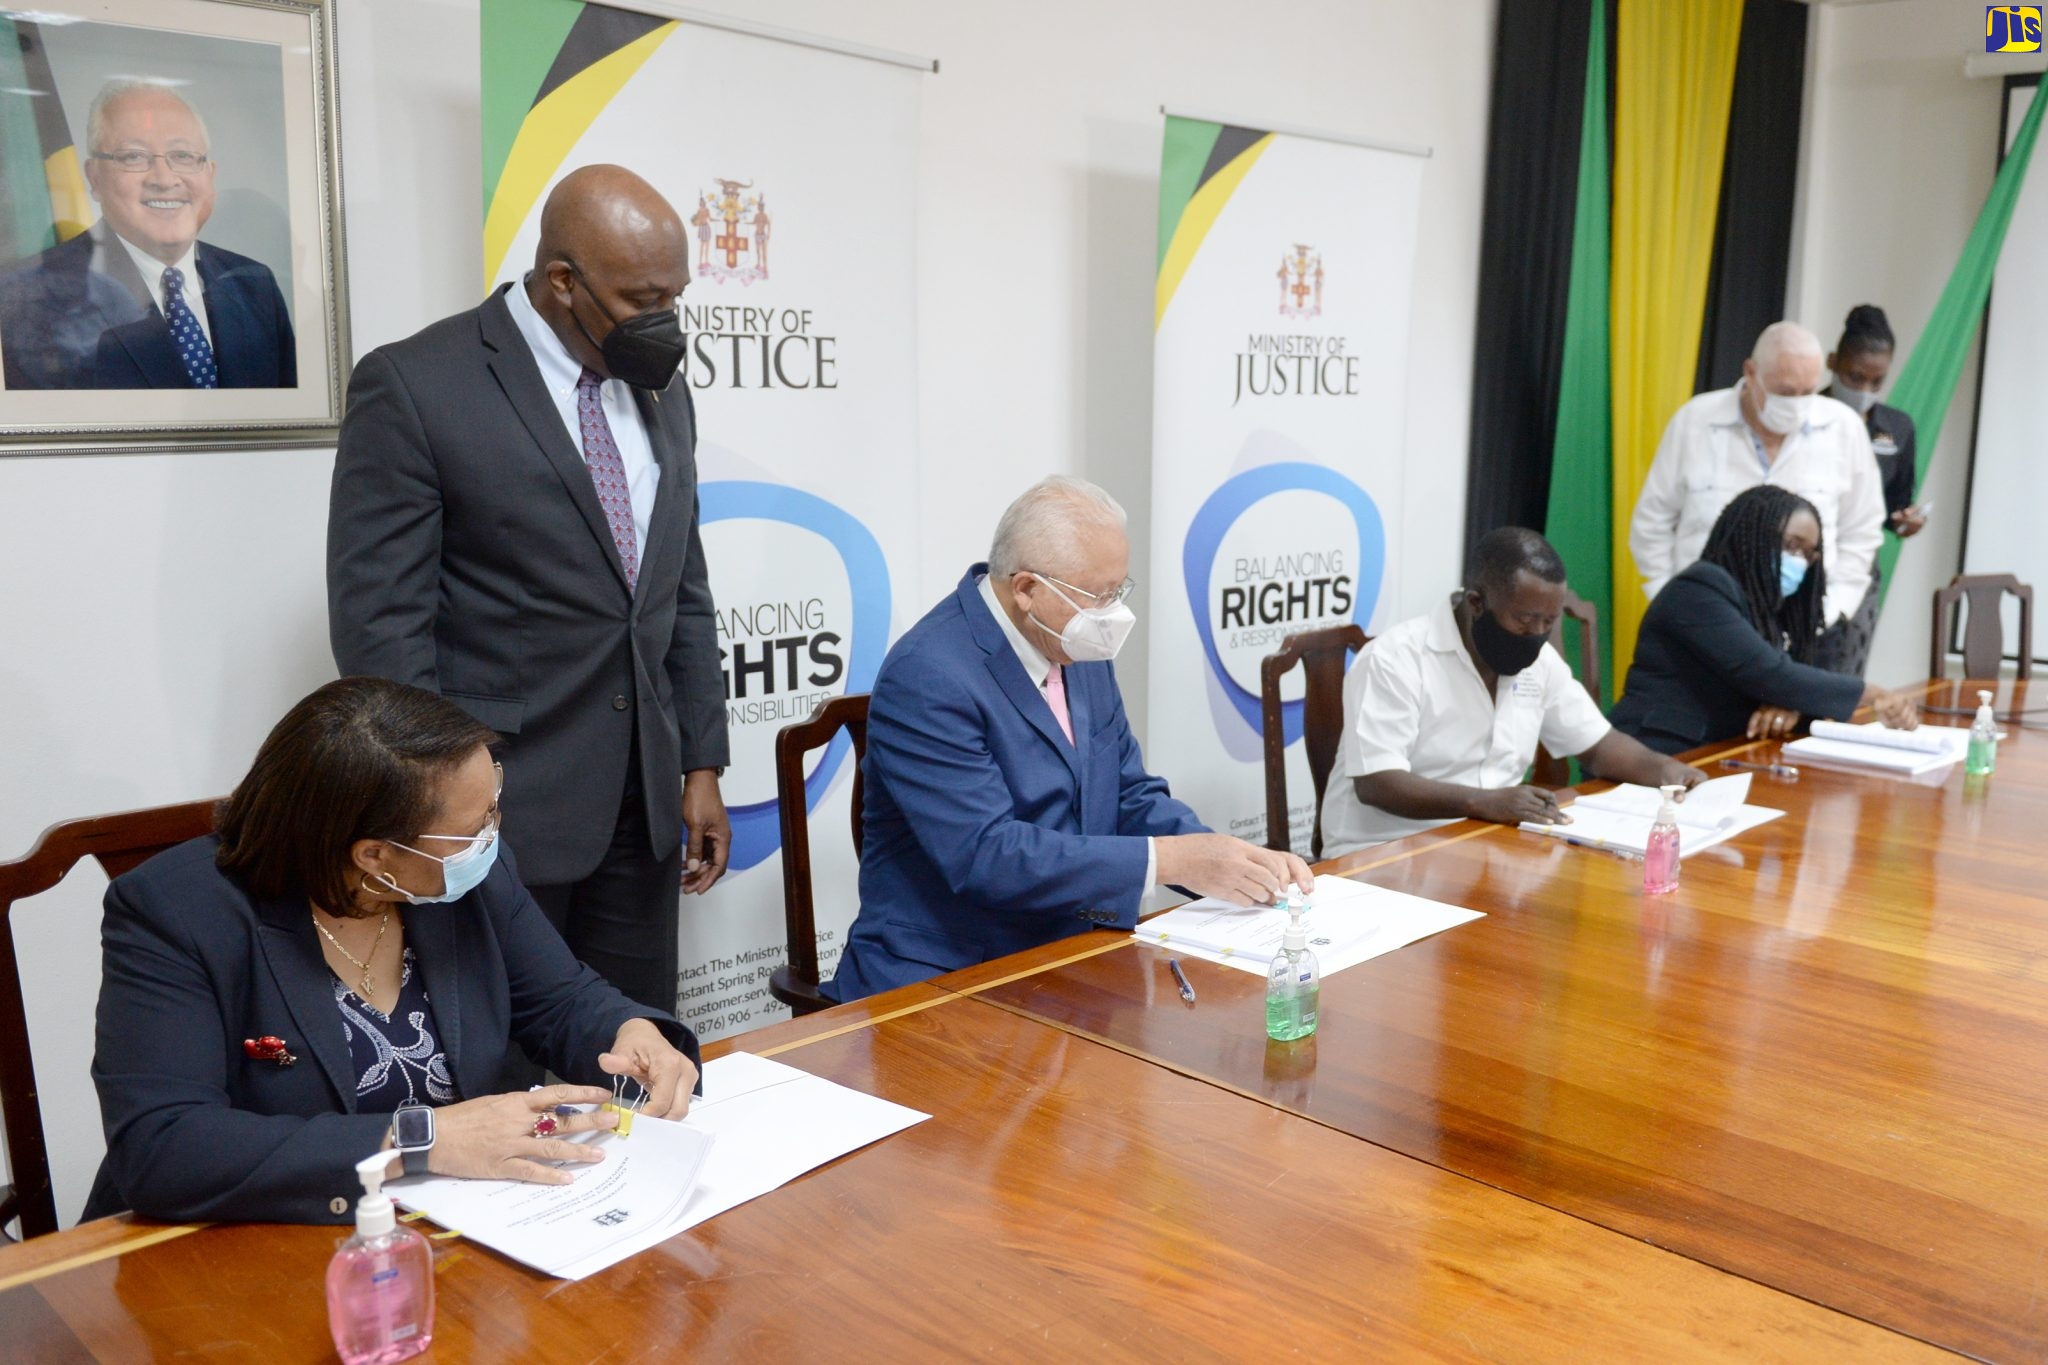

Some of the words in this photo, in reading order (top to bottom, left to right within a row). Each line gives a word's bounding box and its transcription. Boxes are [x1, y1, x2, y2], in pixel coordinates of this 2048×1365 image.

[676, 304, 775, 332] INISTRY
[781, 309, 813, 333] OF
[684, 332, 838, 390] STICE
[1248, 333, 1323, 354] MINISTRY
[1326, 336, 1346, 355] OF
[1231, 353, 1360, 408] JUSTICE
[1234, 549, 1344, 584] BALANCING
[714, 598, 825, 640] ANCING
[1221, 575, 1352, 630] RIGHTS
[677, 964, 708, 982] ntact
[710, 958, 733, 973] The
[736, 944, 783, 967] Ministry
[677, 980, 716, 1002] nstant
[717, 972, 755, 991] Spring
[694, 1015, 725, 1037] (876)
[728, 1010, 751, 1026] 906
